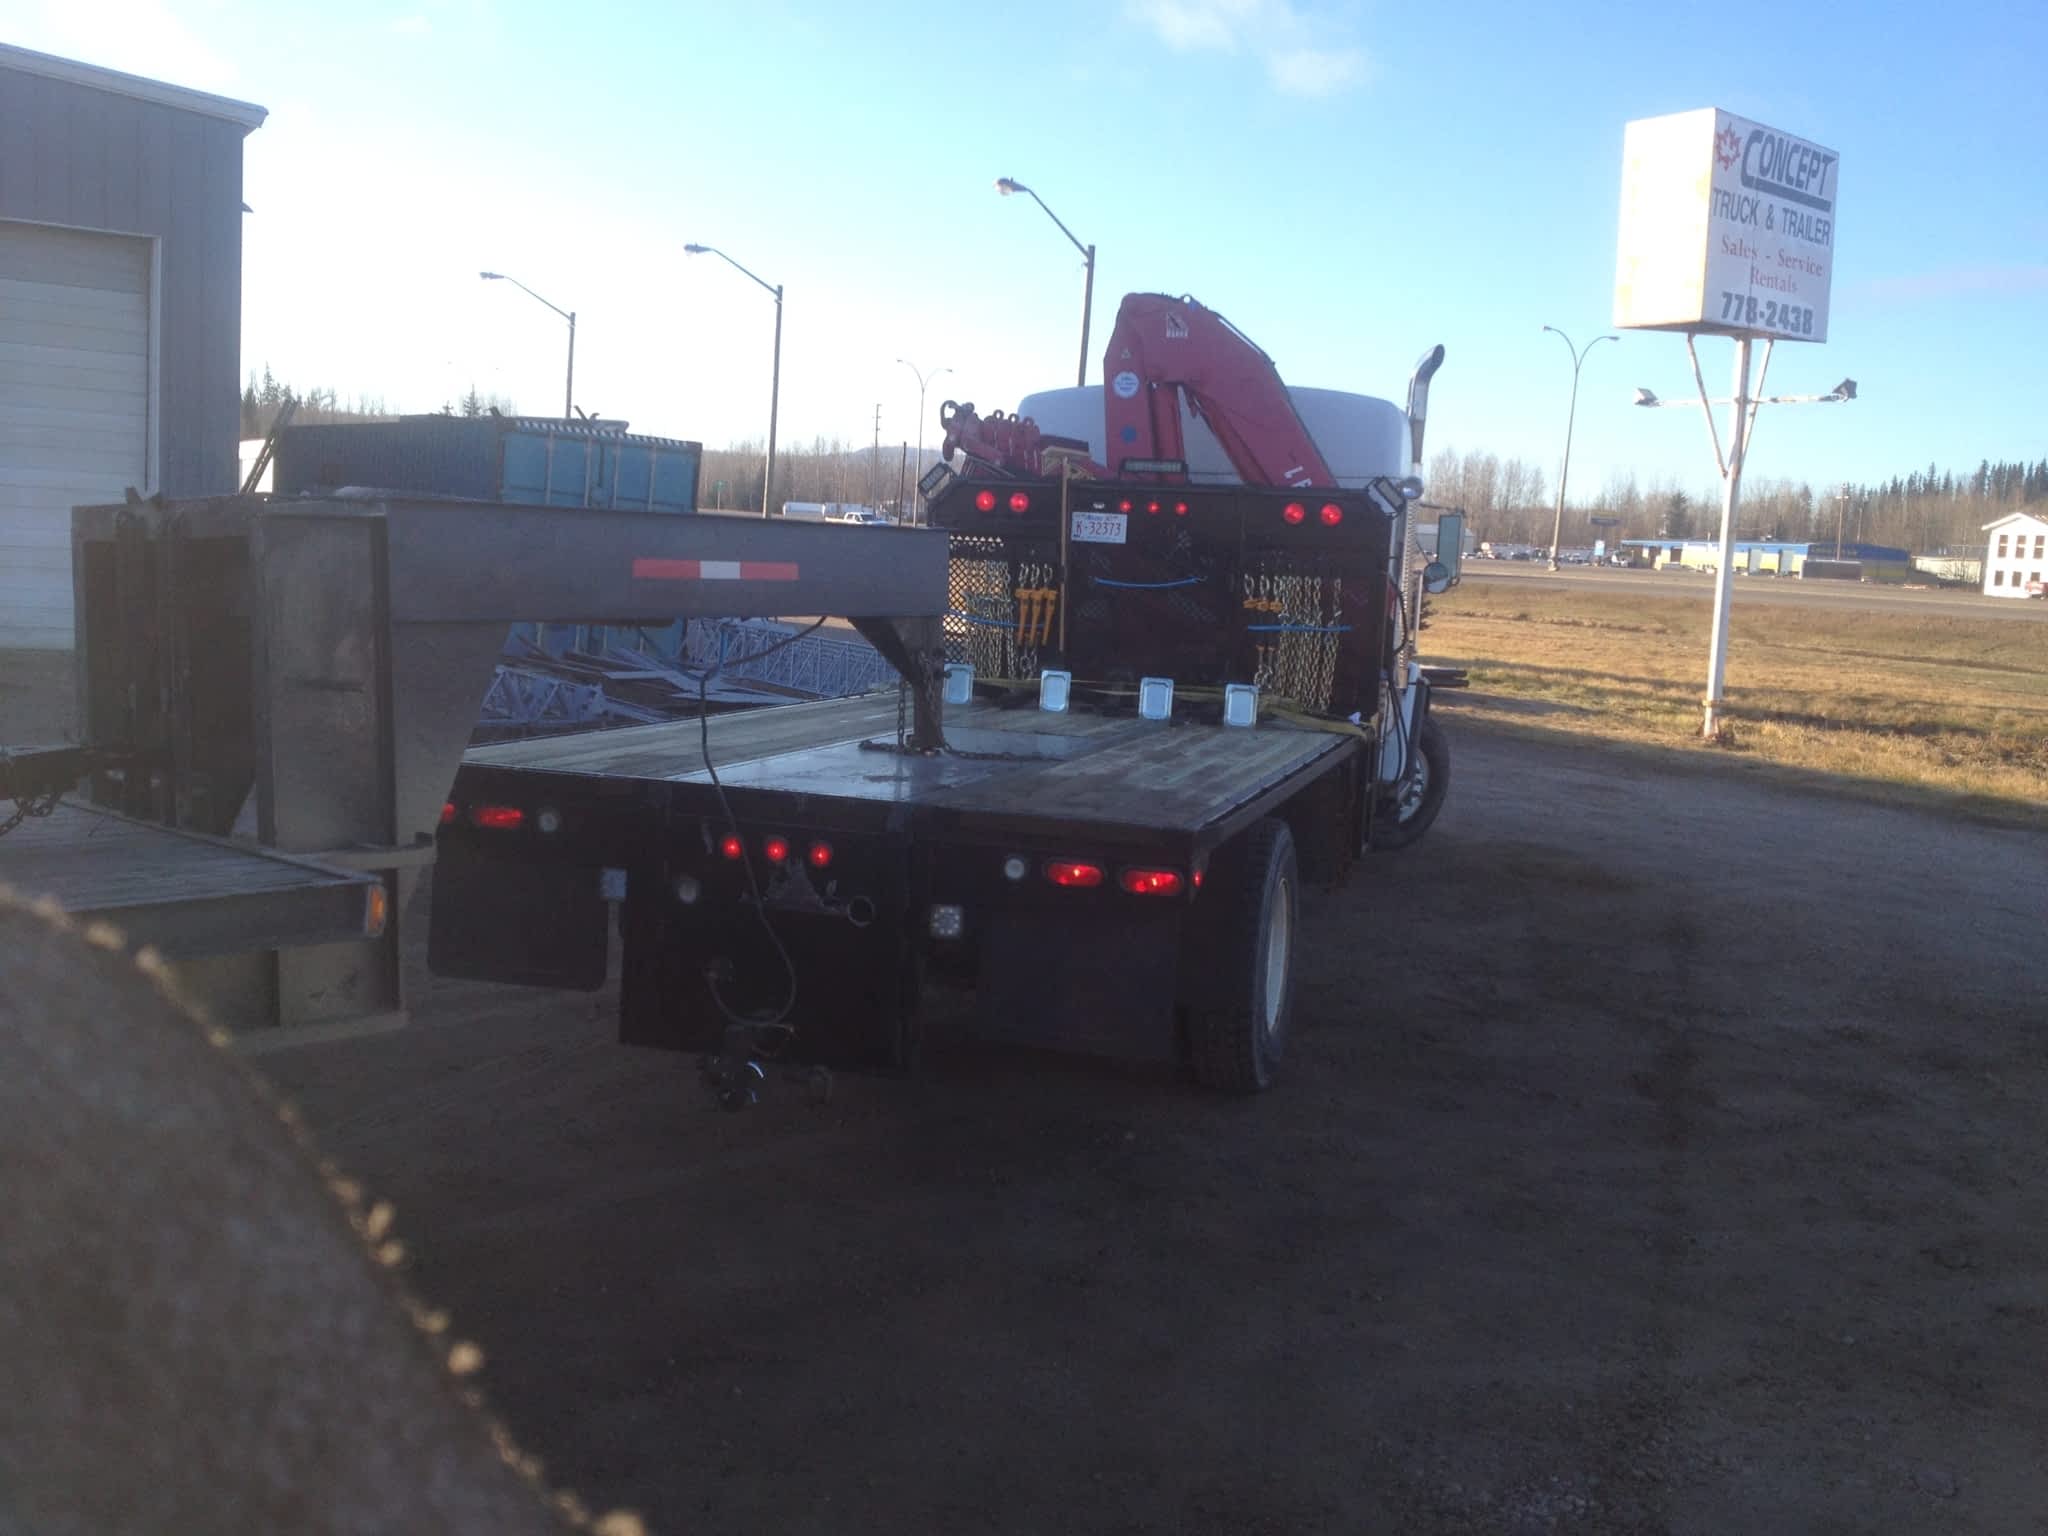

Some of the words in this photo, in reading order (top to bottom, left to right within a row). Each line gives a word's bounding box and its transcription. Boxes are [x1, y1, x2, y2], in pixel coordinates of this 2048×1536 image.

[1741, 130, 1837, 196] CONCEPT
[1713, 187, 1760, 226] TRUCK
[1765, 204, 1774, 231] &
[1782, 207, 1831, 246] TRAILER
[1721, 235, 1758, 260] Sales
[1777, 249, 1823, 277] Service
[1751, 266, 1797, 294] Rentals
[1721, 292, 1813, 335] 778-2438
